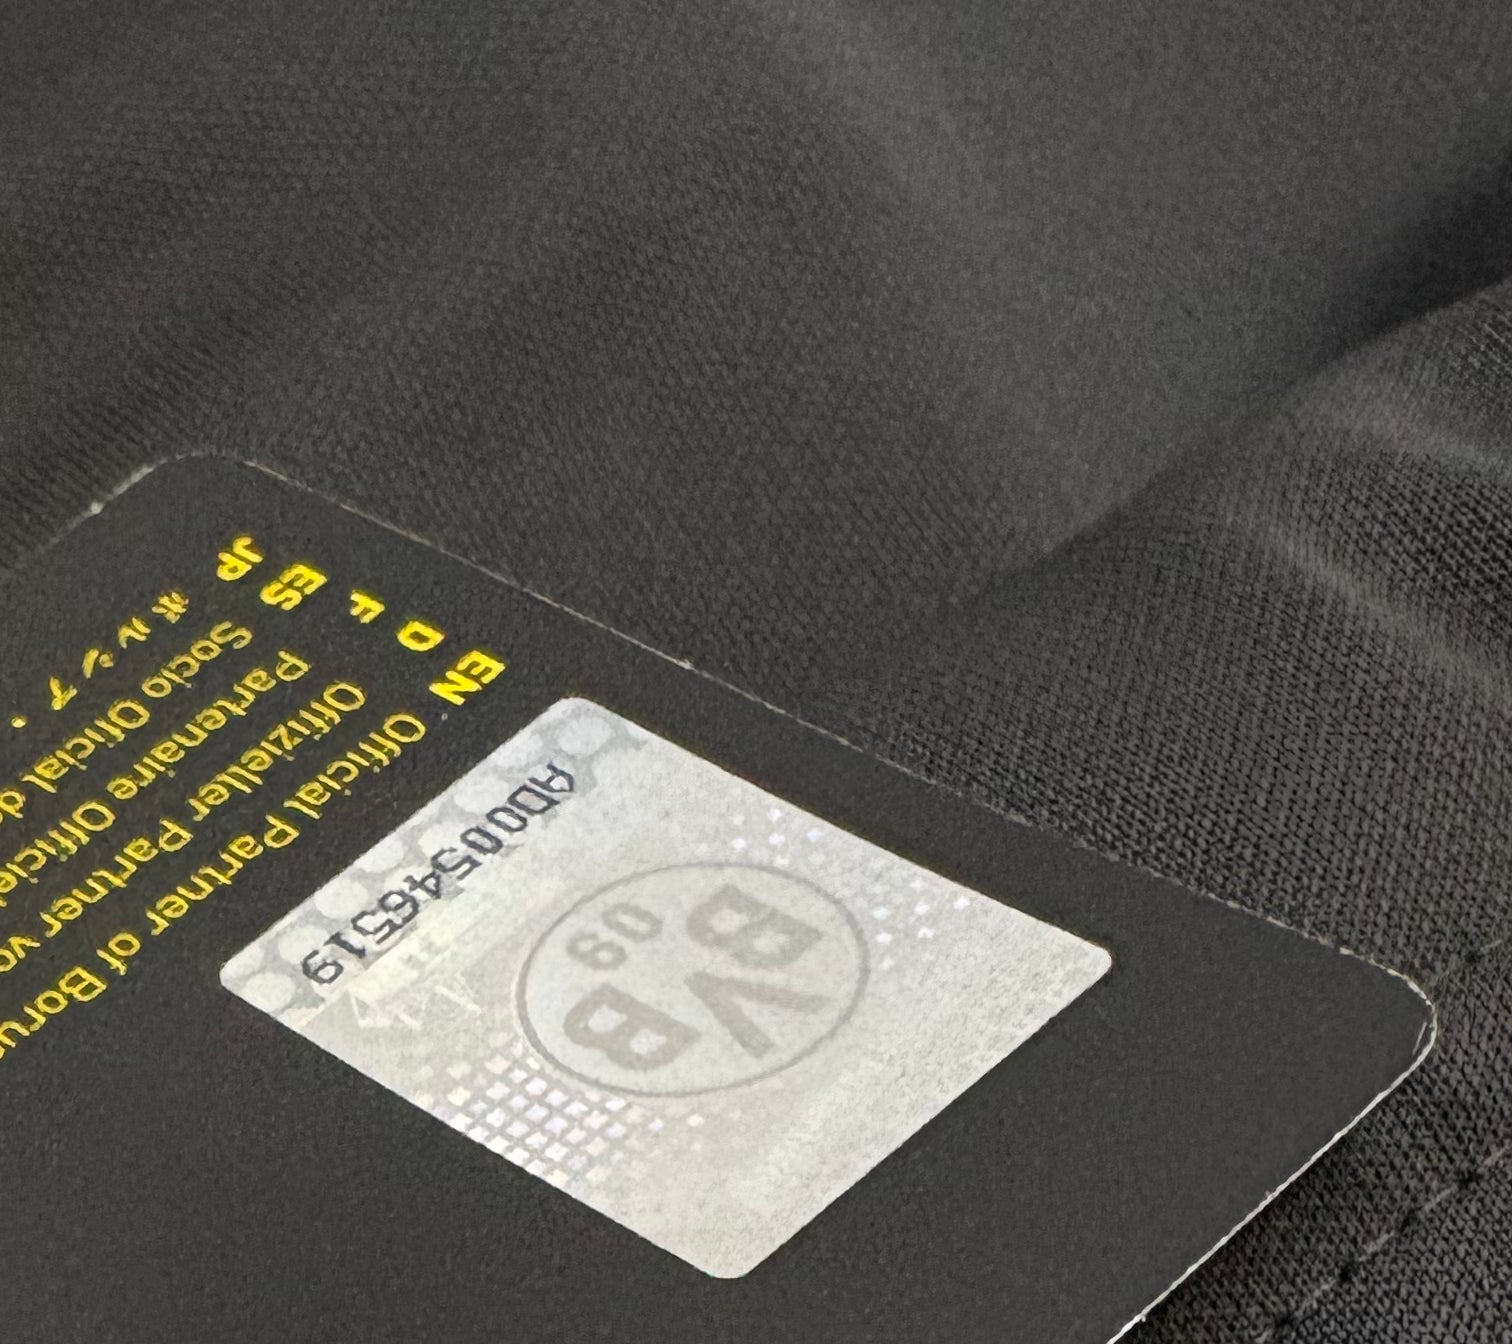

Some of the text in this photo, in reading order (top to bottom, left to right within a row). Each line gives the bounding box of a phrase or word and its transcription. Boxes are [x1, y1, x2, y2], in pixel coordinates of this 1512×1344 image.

[215, 533, 264, 582] JP
[258, 562, 329, 611] ES
[349, 588, 386, 624] F
[395, 620, 446, 652] D
[141, 620, 253, 698] Socio
[429, 649, 506, 706] EN
[105, 650, 311, 800] Partenaire
[189, 680, 367, 818] Offizieller
[285, 711, 427, 818] Official
[40, 817, 193, 937] Partner
[145, 814, 300, 936] Partner
[98, 931, 142, 974] of
[565, 901, 663, 967] 09
[563, 883, 822, 1074] BVB
